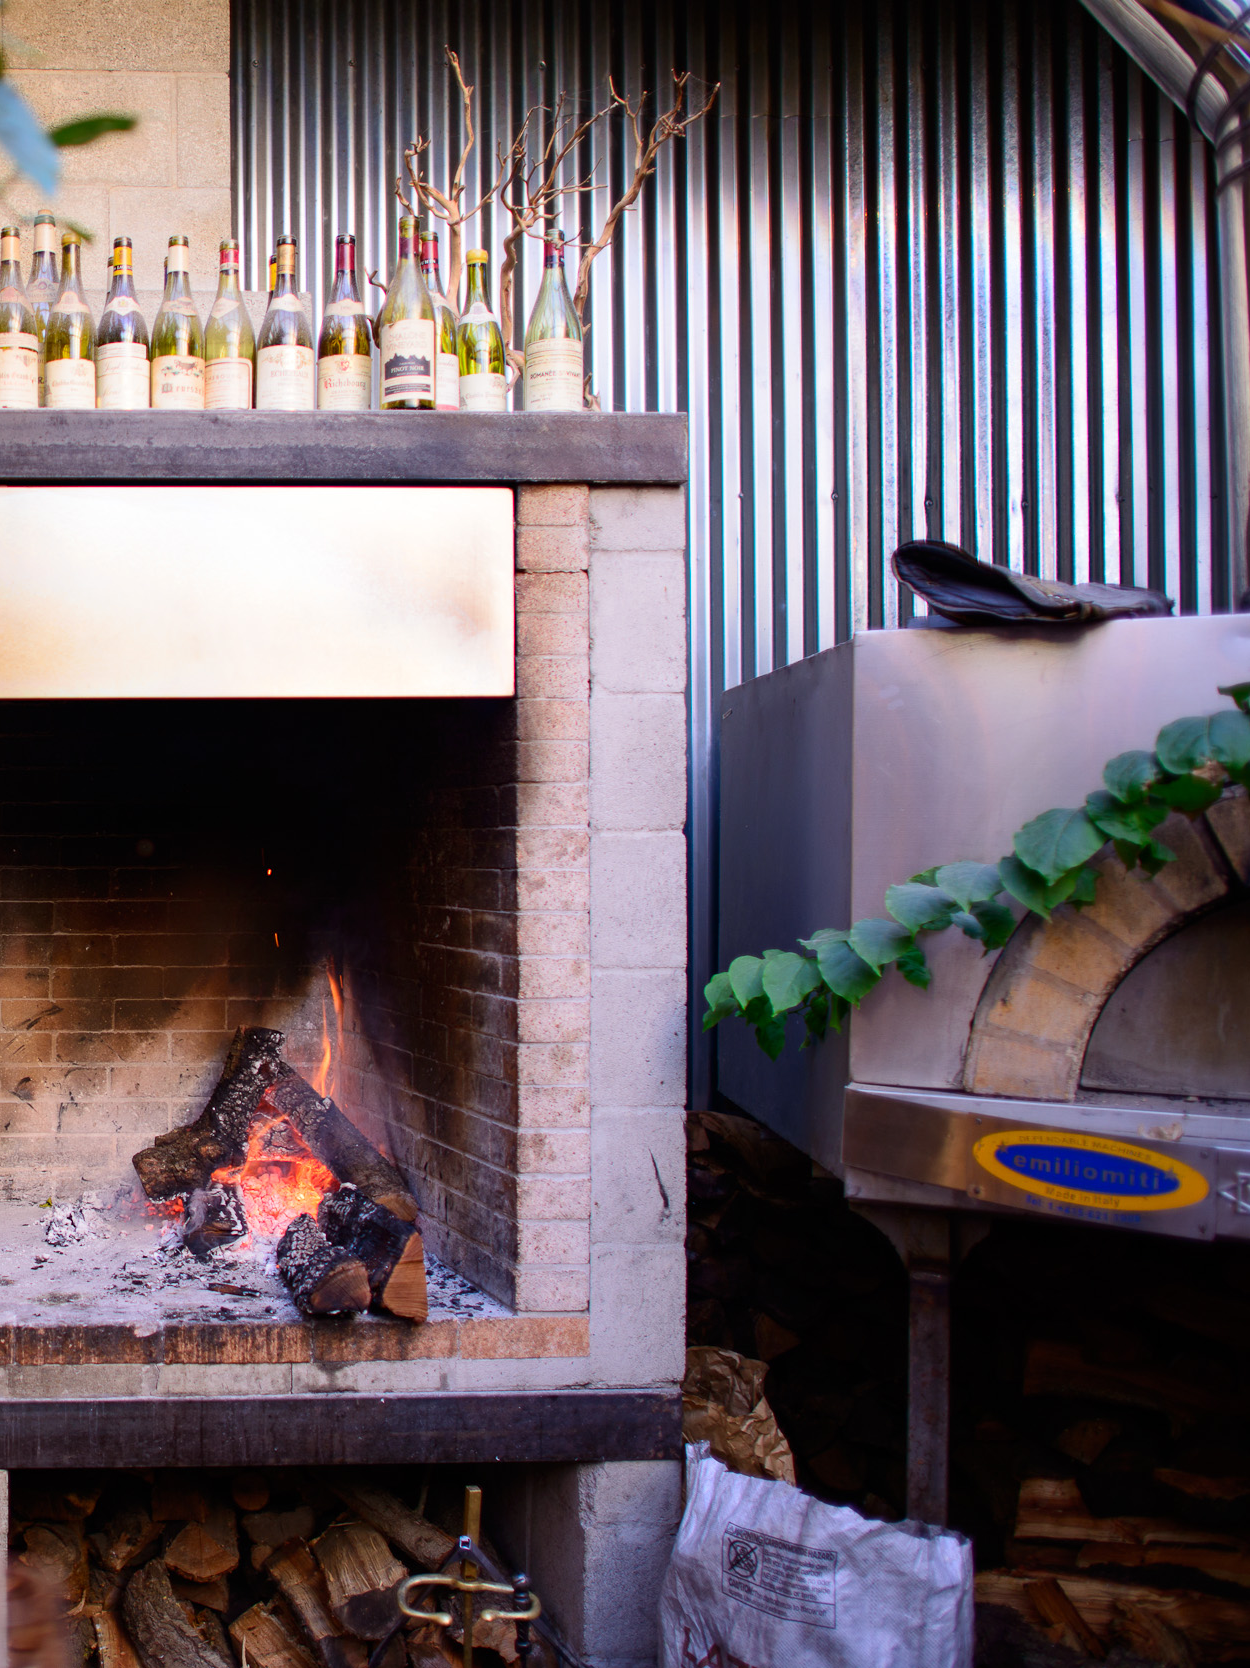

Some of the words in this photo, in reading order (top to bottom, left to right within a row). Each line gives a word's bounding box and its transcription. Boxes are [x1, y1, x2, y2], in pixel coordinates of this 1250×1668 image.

[391, 365, 408, 373] PINOT
[323, 377, 367, 391] Richebourg
[1019, 1135, 1090, 1148] DEPENDABLE
[1092, 1141, 1153, 1161] MACHINES
[1013, 1154, 1161, 1190] emiliomiti
[1045, 1187, 1076, 1201] Made
[1080, 1192, 1091, 1203] in
[1094, 1194, 1121, 1208] Italy
[808, 1550, 835, 1561] HAZARD
